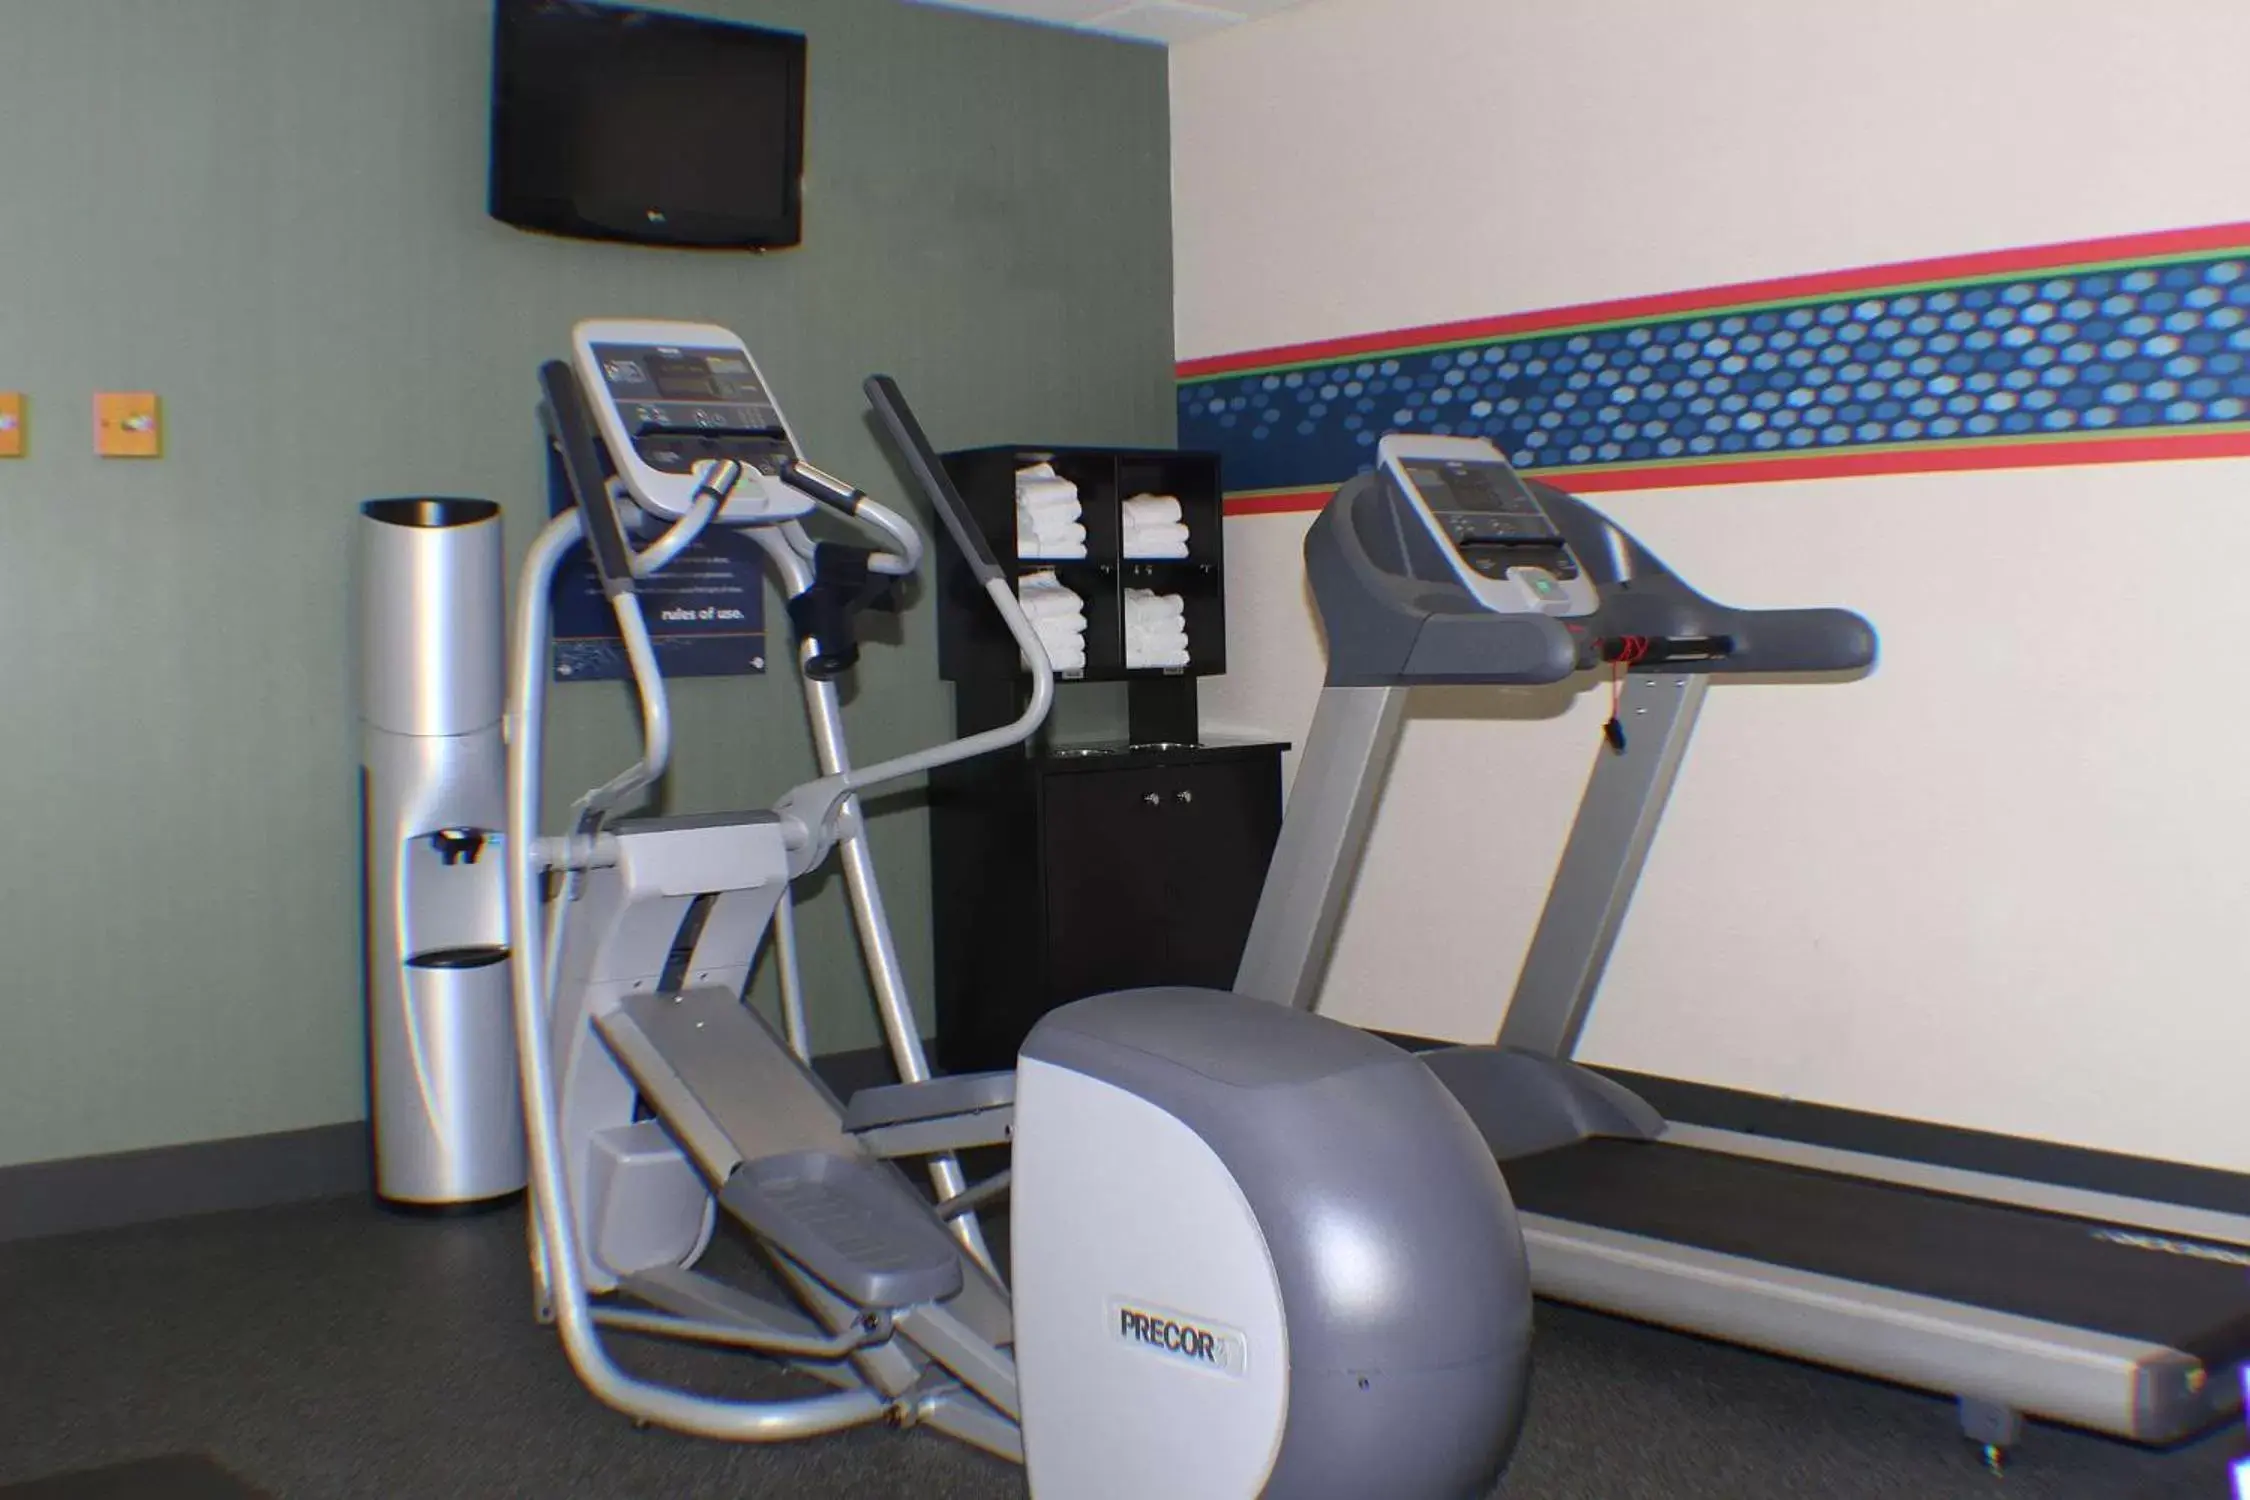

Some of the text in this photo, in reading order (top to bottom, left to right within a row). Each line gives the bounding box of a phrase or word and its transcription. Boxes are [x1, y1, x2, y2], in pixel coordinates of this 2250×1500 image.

[661, 606, 745, 621] rules of use.
[1120, 1307, 1216, 1363] PRECOR
